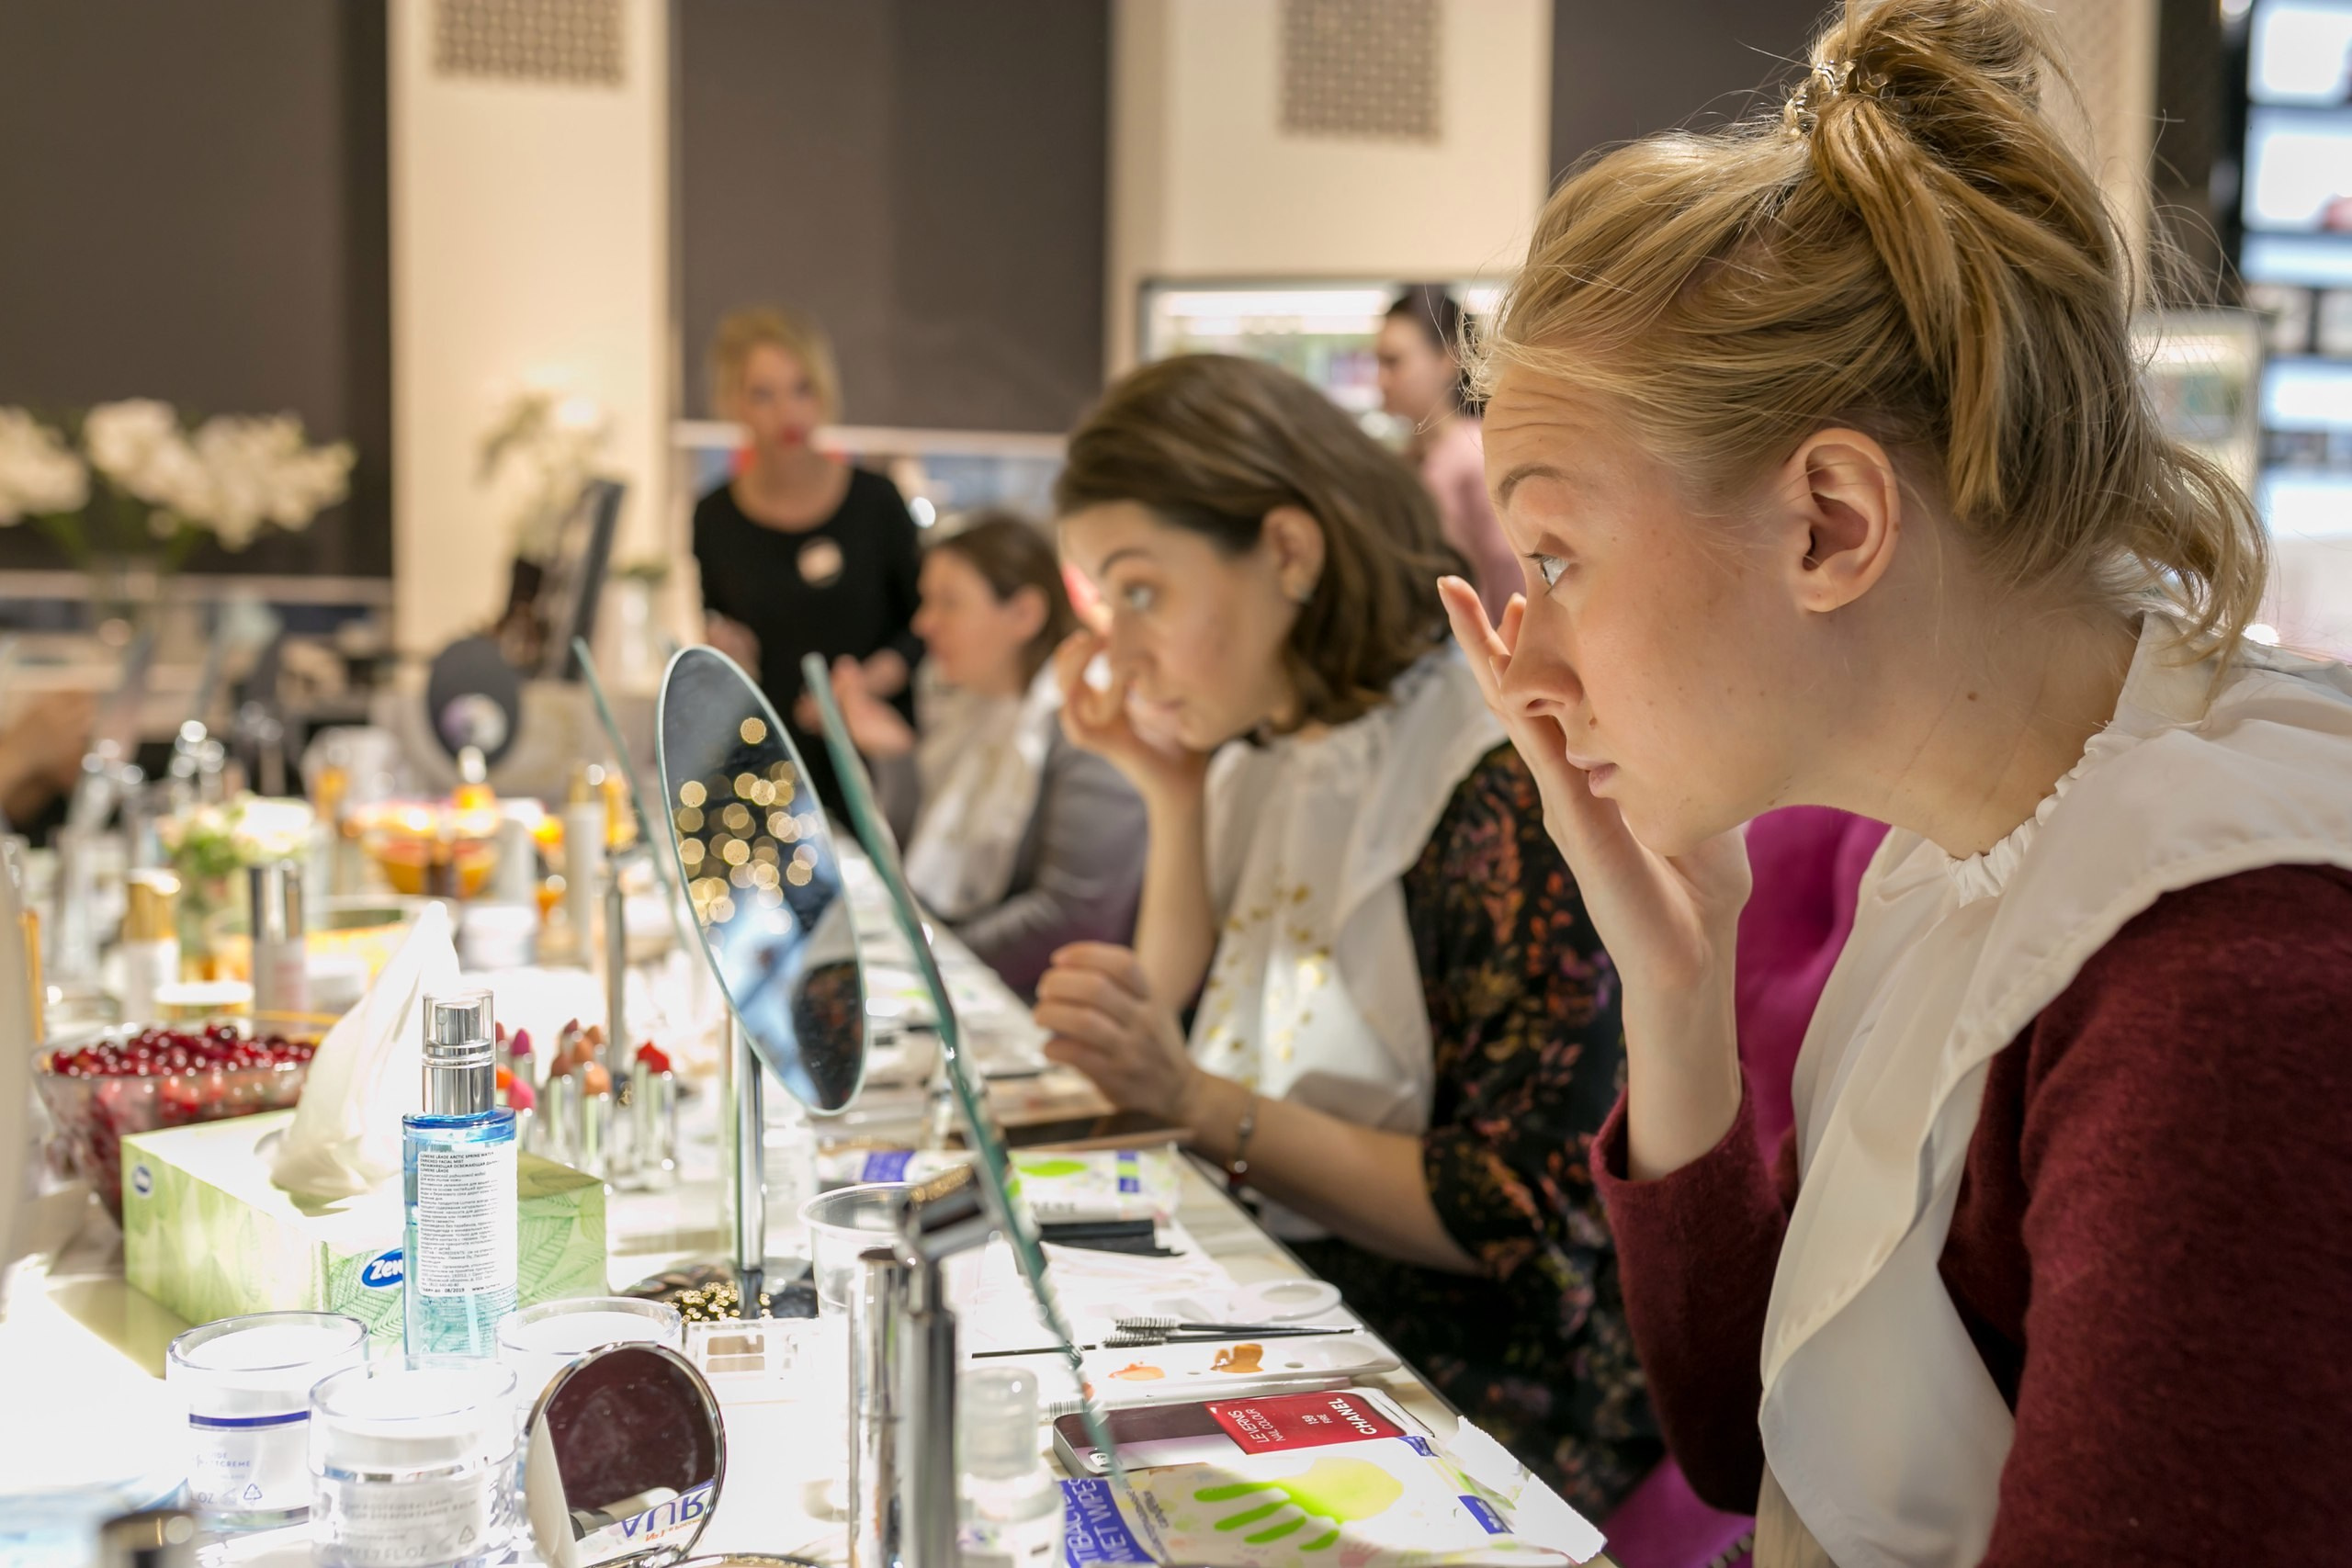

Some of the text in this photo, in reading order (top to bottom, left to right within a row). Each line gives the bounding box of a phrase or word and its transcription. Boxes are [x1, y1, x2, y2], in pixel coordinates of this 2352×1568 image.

[1227, 1410, 1270, 1443] LE VERNIS
[1245, 1408, 1285, 1441] NAIL COLOUR
[1301, 1415, 1319, 1425] 159
[1316, 1414, 1333, 1424] FIRE
[1329, 1397, 1377, 1435] CHANEL
